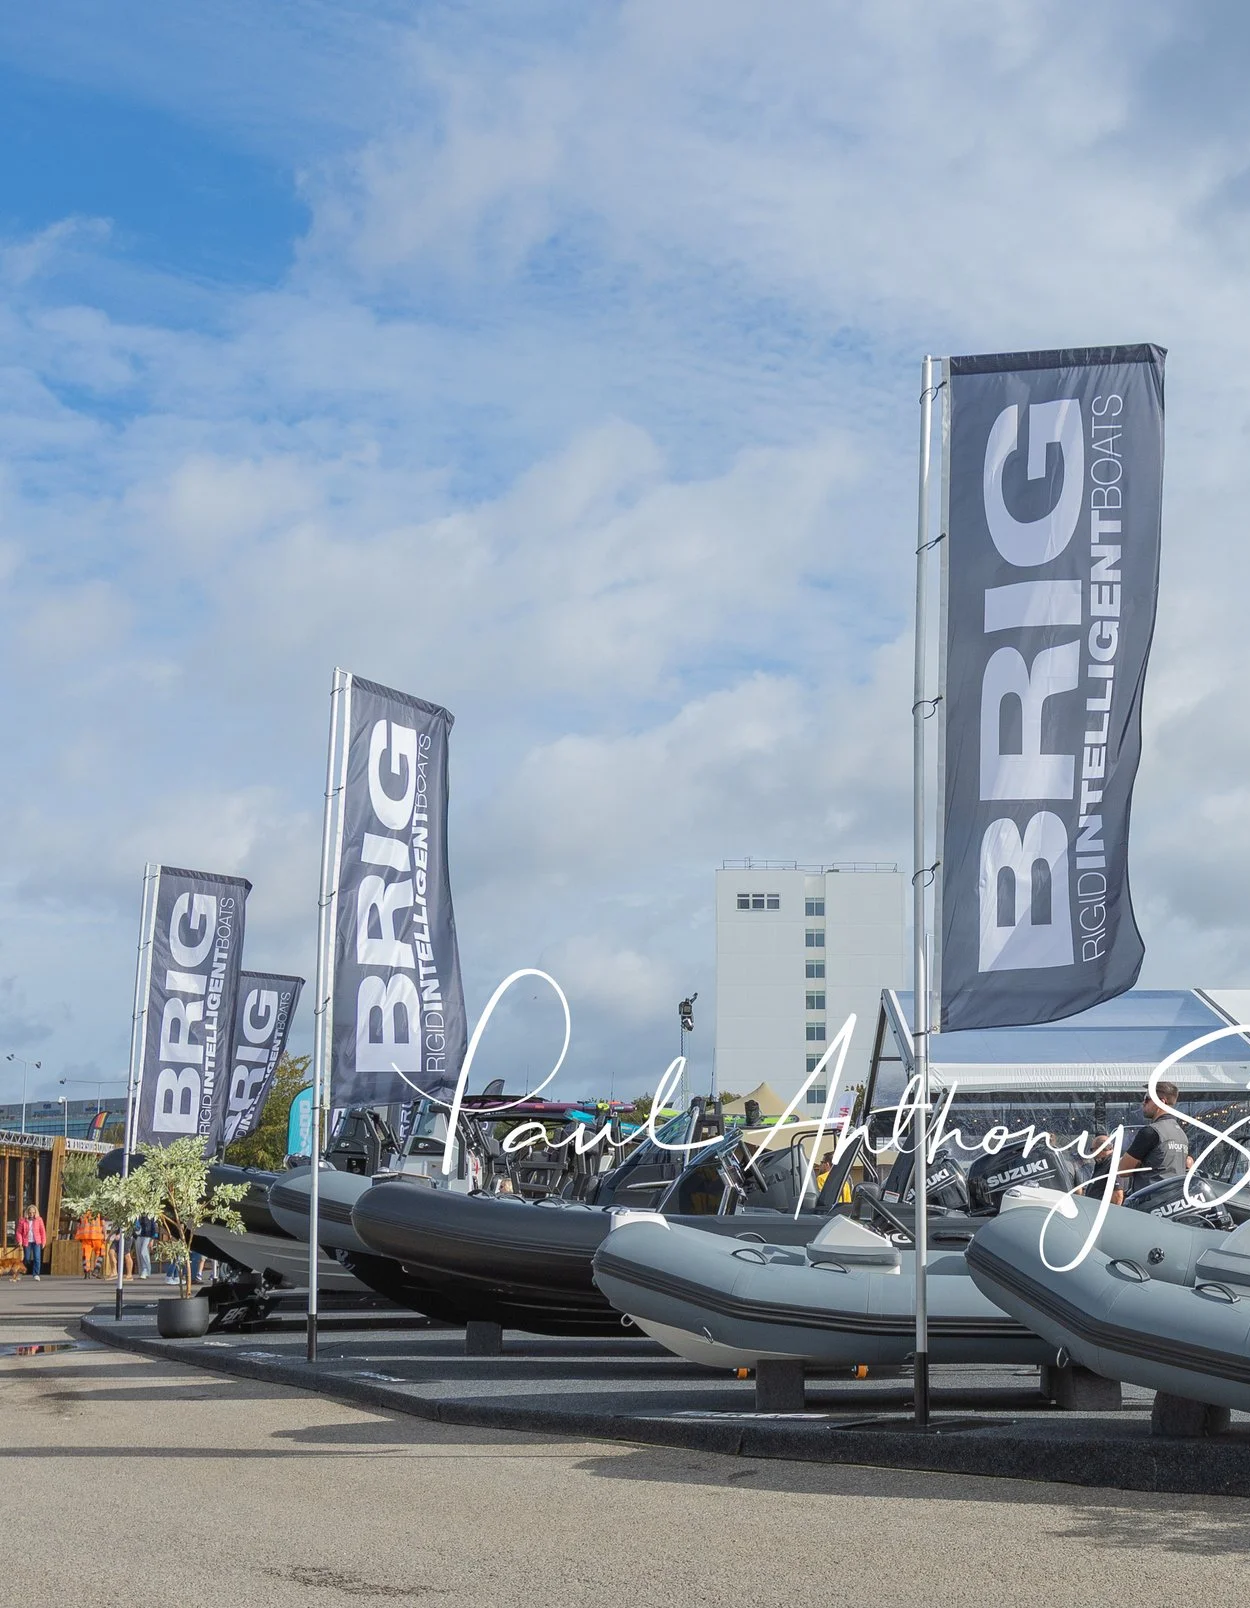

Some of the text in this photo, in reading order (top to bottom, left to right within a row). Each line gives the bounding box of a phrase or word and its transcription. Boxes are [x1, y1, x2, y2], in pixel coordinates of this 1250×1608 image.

[977, 398, 1085, 973] BRIG
[152, 891, 217, 1134] BRIG
[354, 718, 423, 1073] BRIG
[906, 1168, 950, 1201] SUKI
[986, 1158, 1049, 1187] SUZUKI
